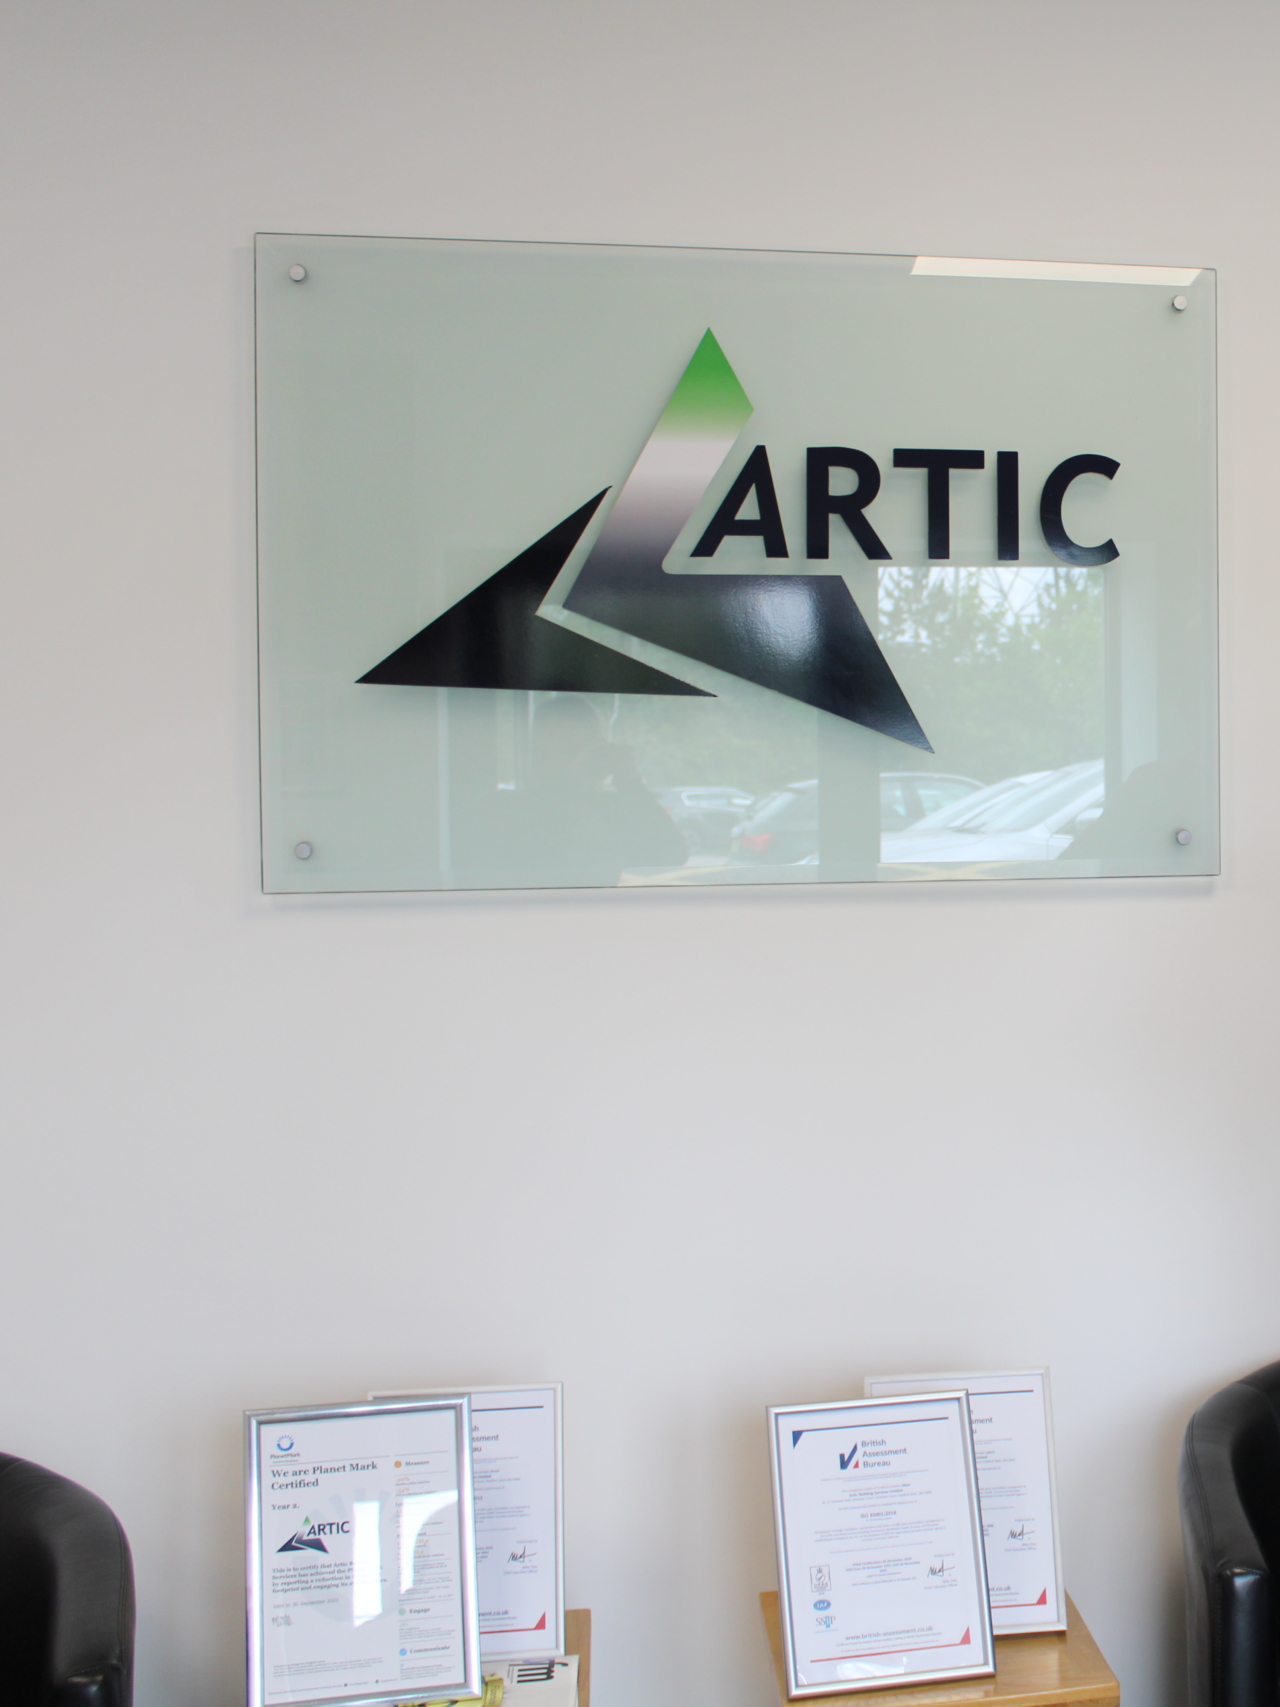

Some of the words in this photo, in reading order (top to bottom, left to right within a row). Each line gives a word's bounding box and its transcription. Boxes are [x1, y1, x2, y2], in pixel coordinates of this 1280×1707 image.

[689, 444, 1122, 567] ARTIC
[861, 1439, 886, 1448] British
[862, 1447, 907, 1458] Assessment
[271, 1469, 290, 1478] We
[292, 1469, 310, 1477] are
[312, 1464, 347, 1475] Planet
[349, 1461, 378, 1472] Mark
[863, 1460, 891, 1469] Bureau
[271, 1478, 319, 1491] Certified
[271, 1503, 291, 1511] Year
[306, 1521, 351, 1537] ARTIC
[845, 1626, 933, 1641] www.british-assessment.co.uk
[409, 1645, 450, 1654] Communicate
